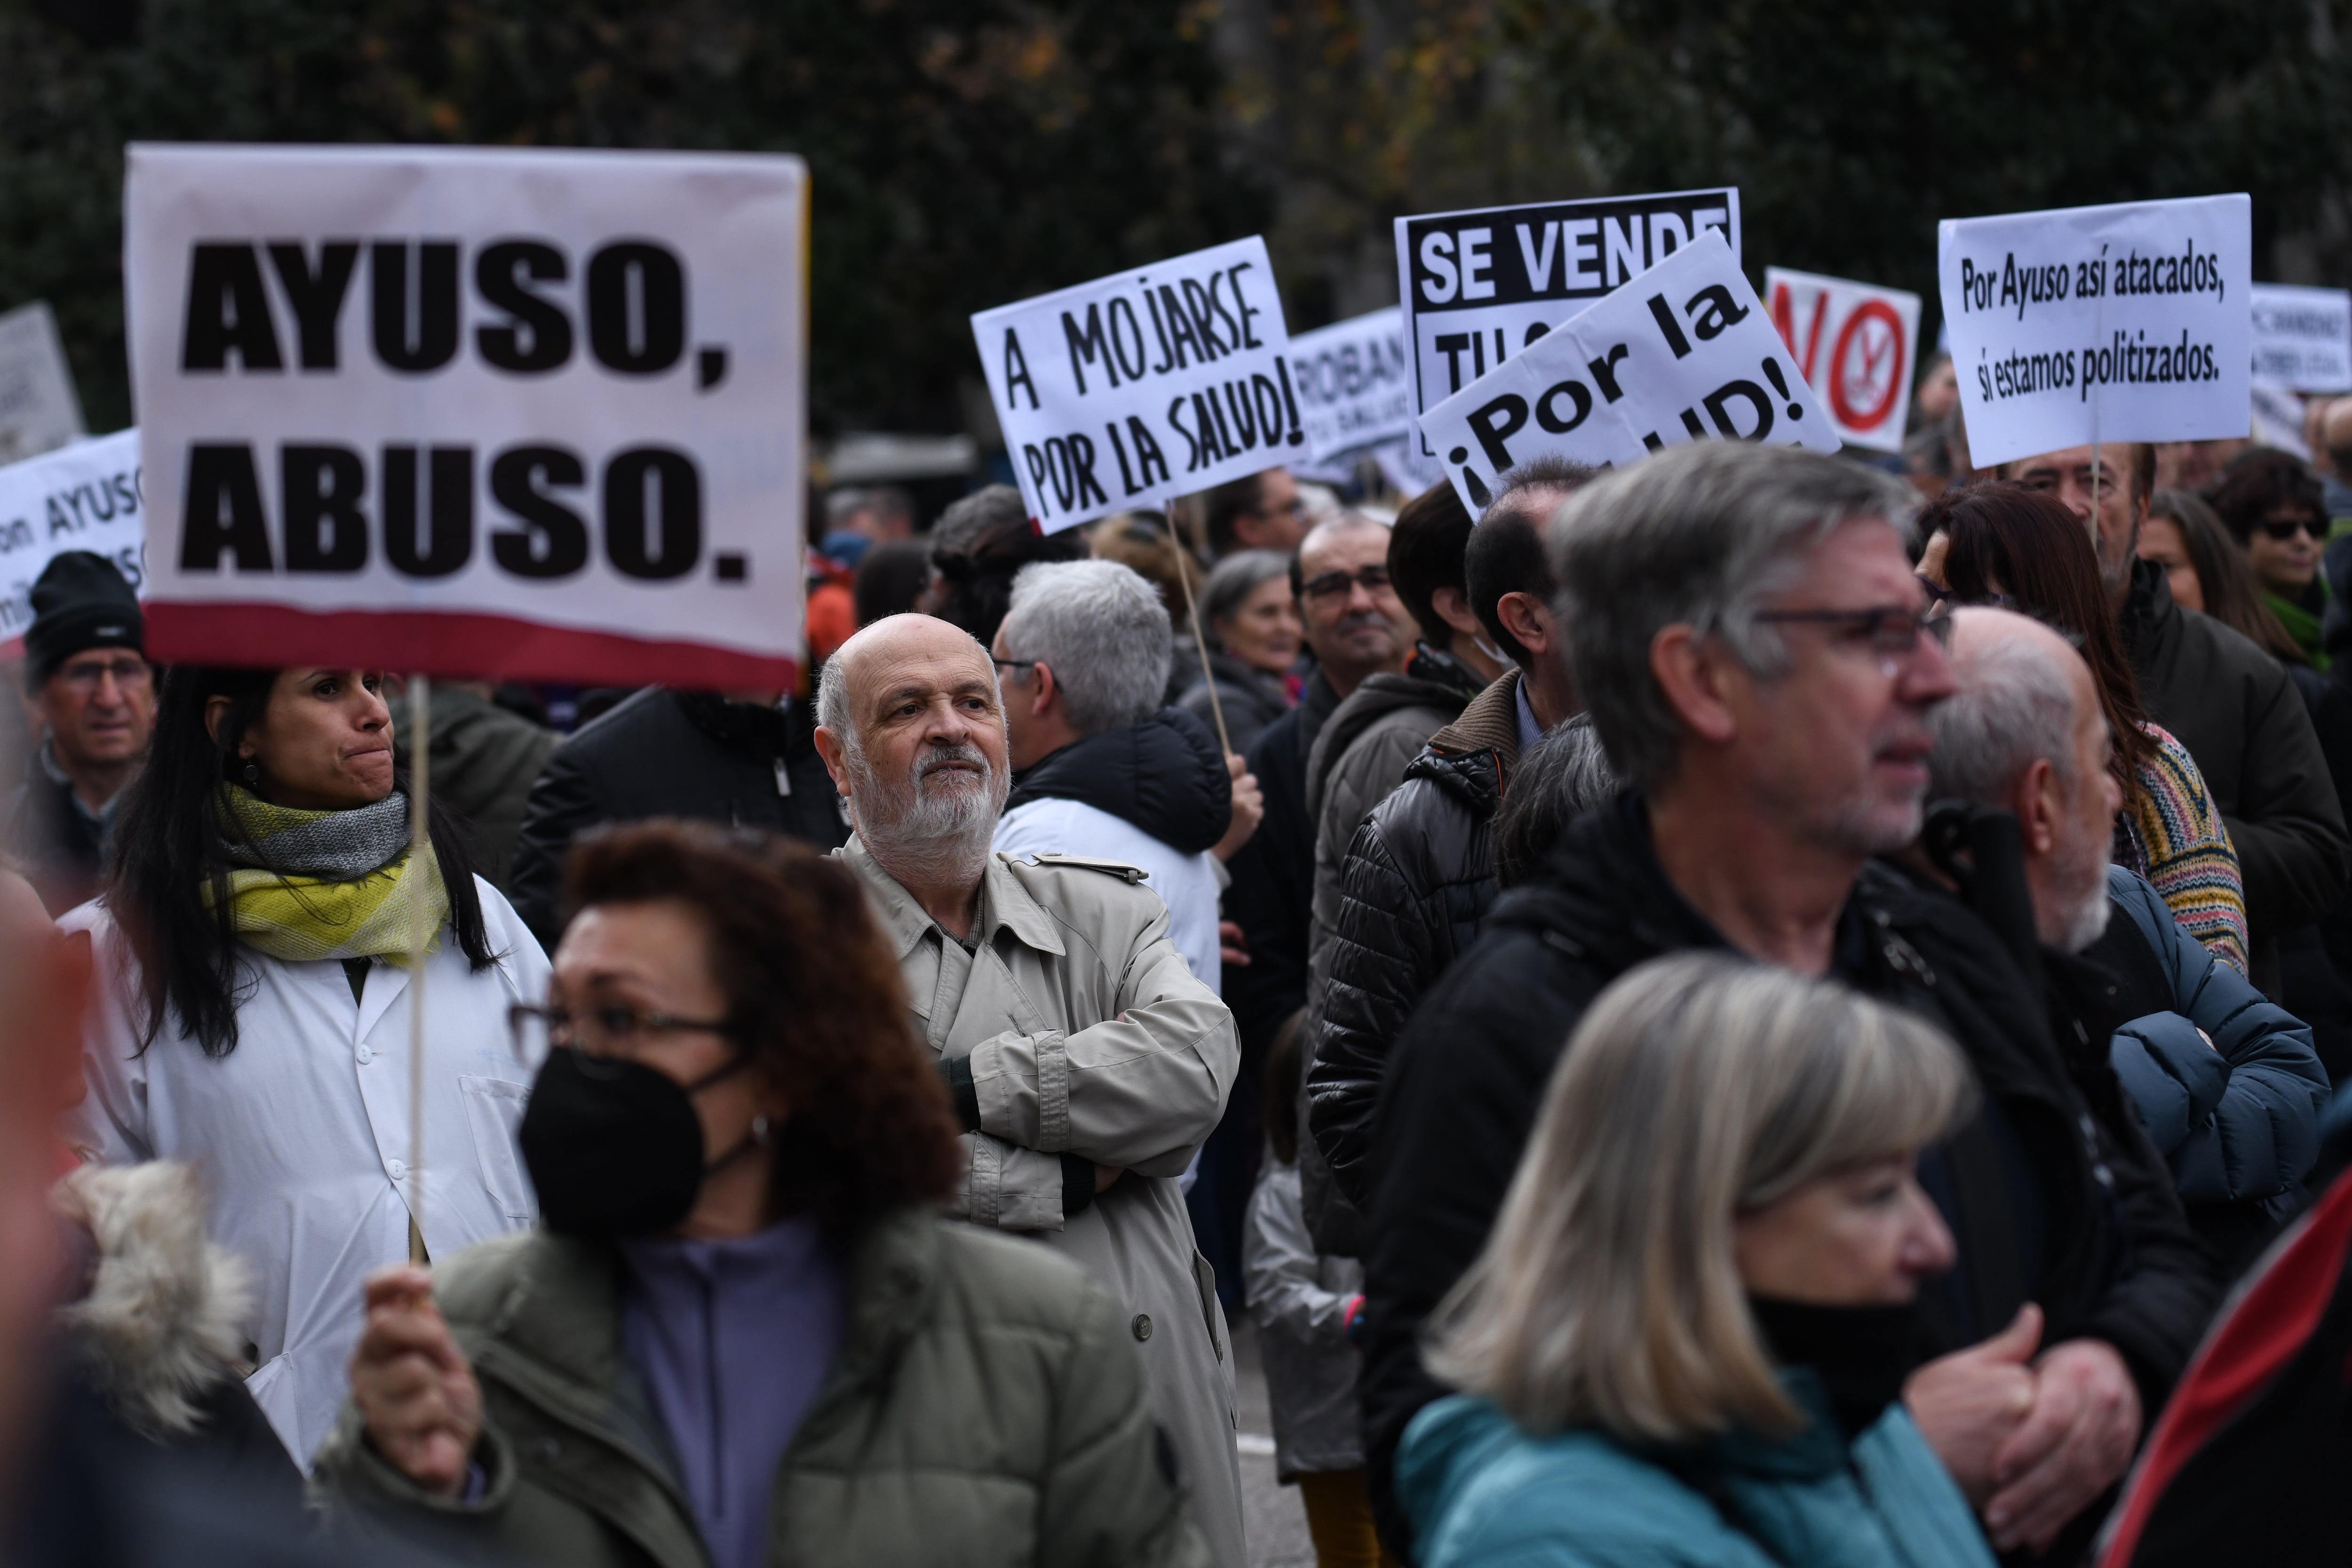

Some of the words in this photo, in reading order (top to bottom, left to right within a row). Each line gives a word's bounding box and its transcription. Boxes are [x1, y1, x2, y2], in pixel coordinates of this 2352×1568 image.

[180, 238, 729, 393] AYUSO,
[1003, 326, 1041, 410] A
[1060, 261, 1263, 397] MOJARSE
[1420, 227, 1495, 304] SE
[1962, 258, 1997, 313] Por
[2001, 252, 2069, 321] Ayuso
[2075, 244, 2108, 299] así
[2114, 238, 2225, 304] atacados,
[1023, 432, 1110, 518] POR
[1105, 414, 1171, 497] LA
[1167, 355, 1305, 473] SALUD!
[1448, 342, 1629, 509] ¡Por
[1646, 283, 1750, 361] la
[1996, 347, 2075, 399] estamos
[2082, 328, 2220, 403] politizados.
[46, 469, 144, 542] AYUS
[179, 440, 749, 584] ABUSO.
